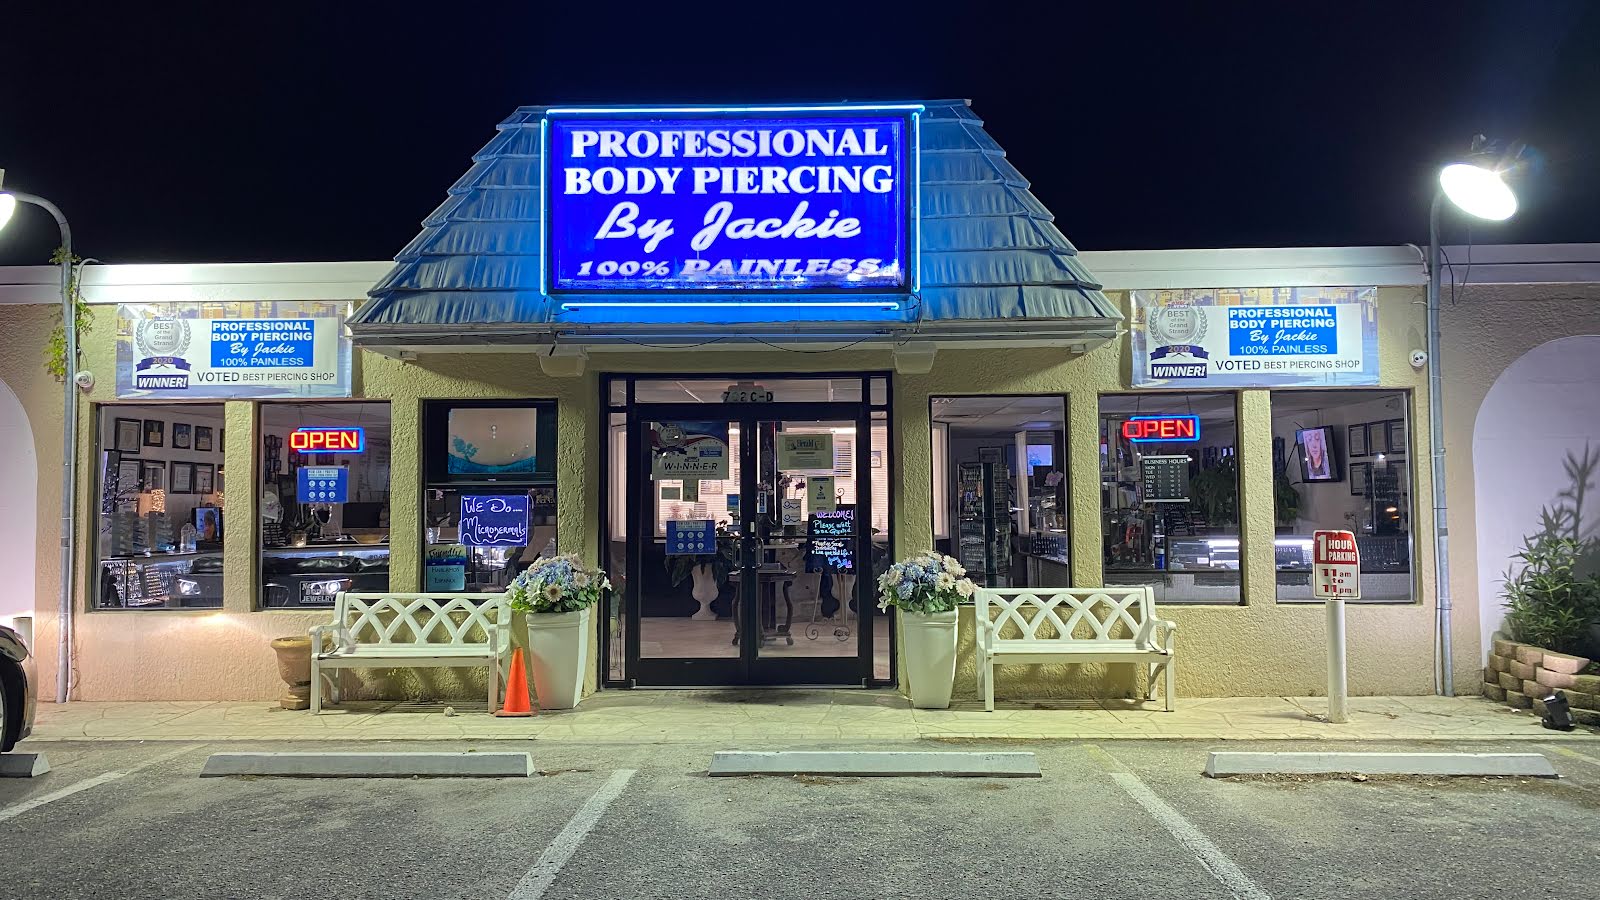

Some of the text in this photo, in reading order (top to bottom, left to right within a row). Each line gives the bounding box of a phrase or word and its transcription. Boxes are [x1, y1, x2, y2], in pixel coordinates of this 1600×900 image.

[570, 128, 888, 158] PROFESSIONAL
[563, 165, 894, 195] BODY PIERCING
[594, 200, 862, 253] By Jackie
[577, 258, 883, 277] 100% PAINLESS
[1229, 308, 1332, 318] PROFESSIONAL
[212, 321, 311, 331] PROFESSIONAL
[1229, 318, 1336, 329] BODY PIERCING
[212, 332, 313, 341] BODY PIERCING
[1249, 329, 1318, 345] By Jackie
[229, 342, 296, 357] By Jackie
[1168, 345, 1190, 353] 2020
[1239, 344, 1328, 354] 100% PAINLESS
[220, 357, 304, 366] 100% PAINLESS
[1215, 359, 1360, 371] VOTED BEST PIERCING SHOP
[196, 371, 335, 382] VOTED BEST PIERCING SHOP
[1153, 366, 1206, 377] WINNER!
[138, 377, 188, 388] WINNER!
[1122, 419, 1194, 438] OPEN
[289, 431, 357, 449] OPEN
[1317, 534, 1353, 561] 1 HOUR
[1328, 551, 1356, 562] PARKING
[1321, 568, 1337, 577] 11
[1322, 584, 1337, 593] 11
